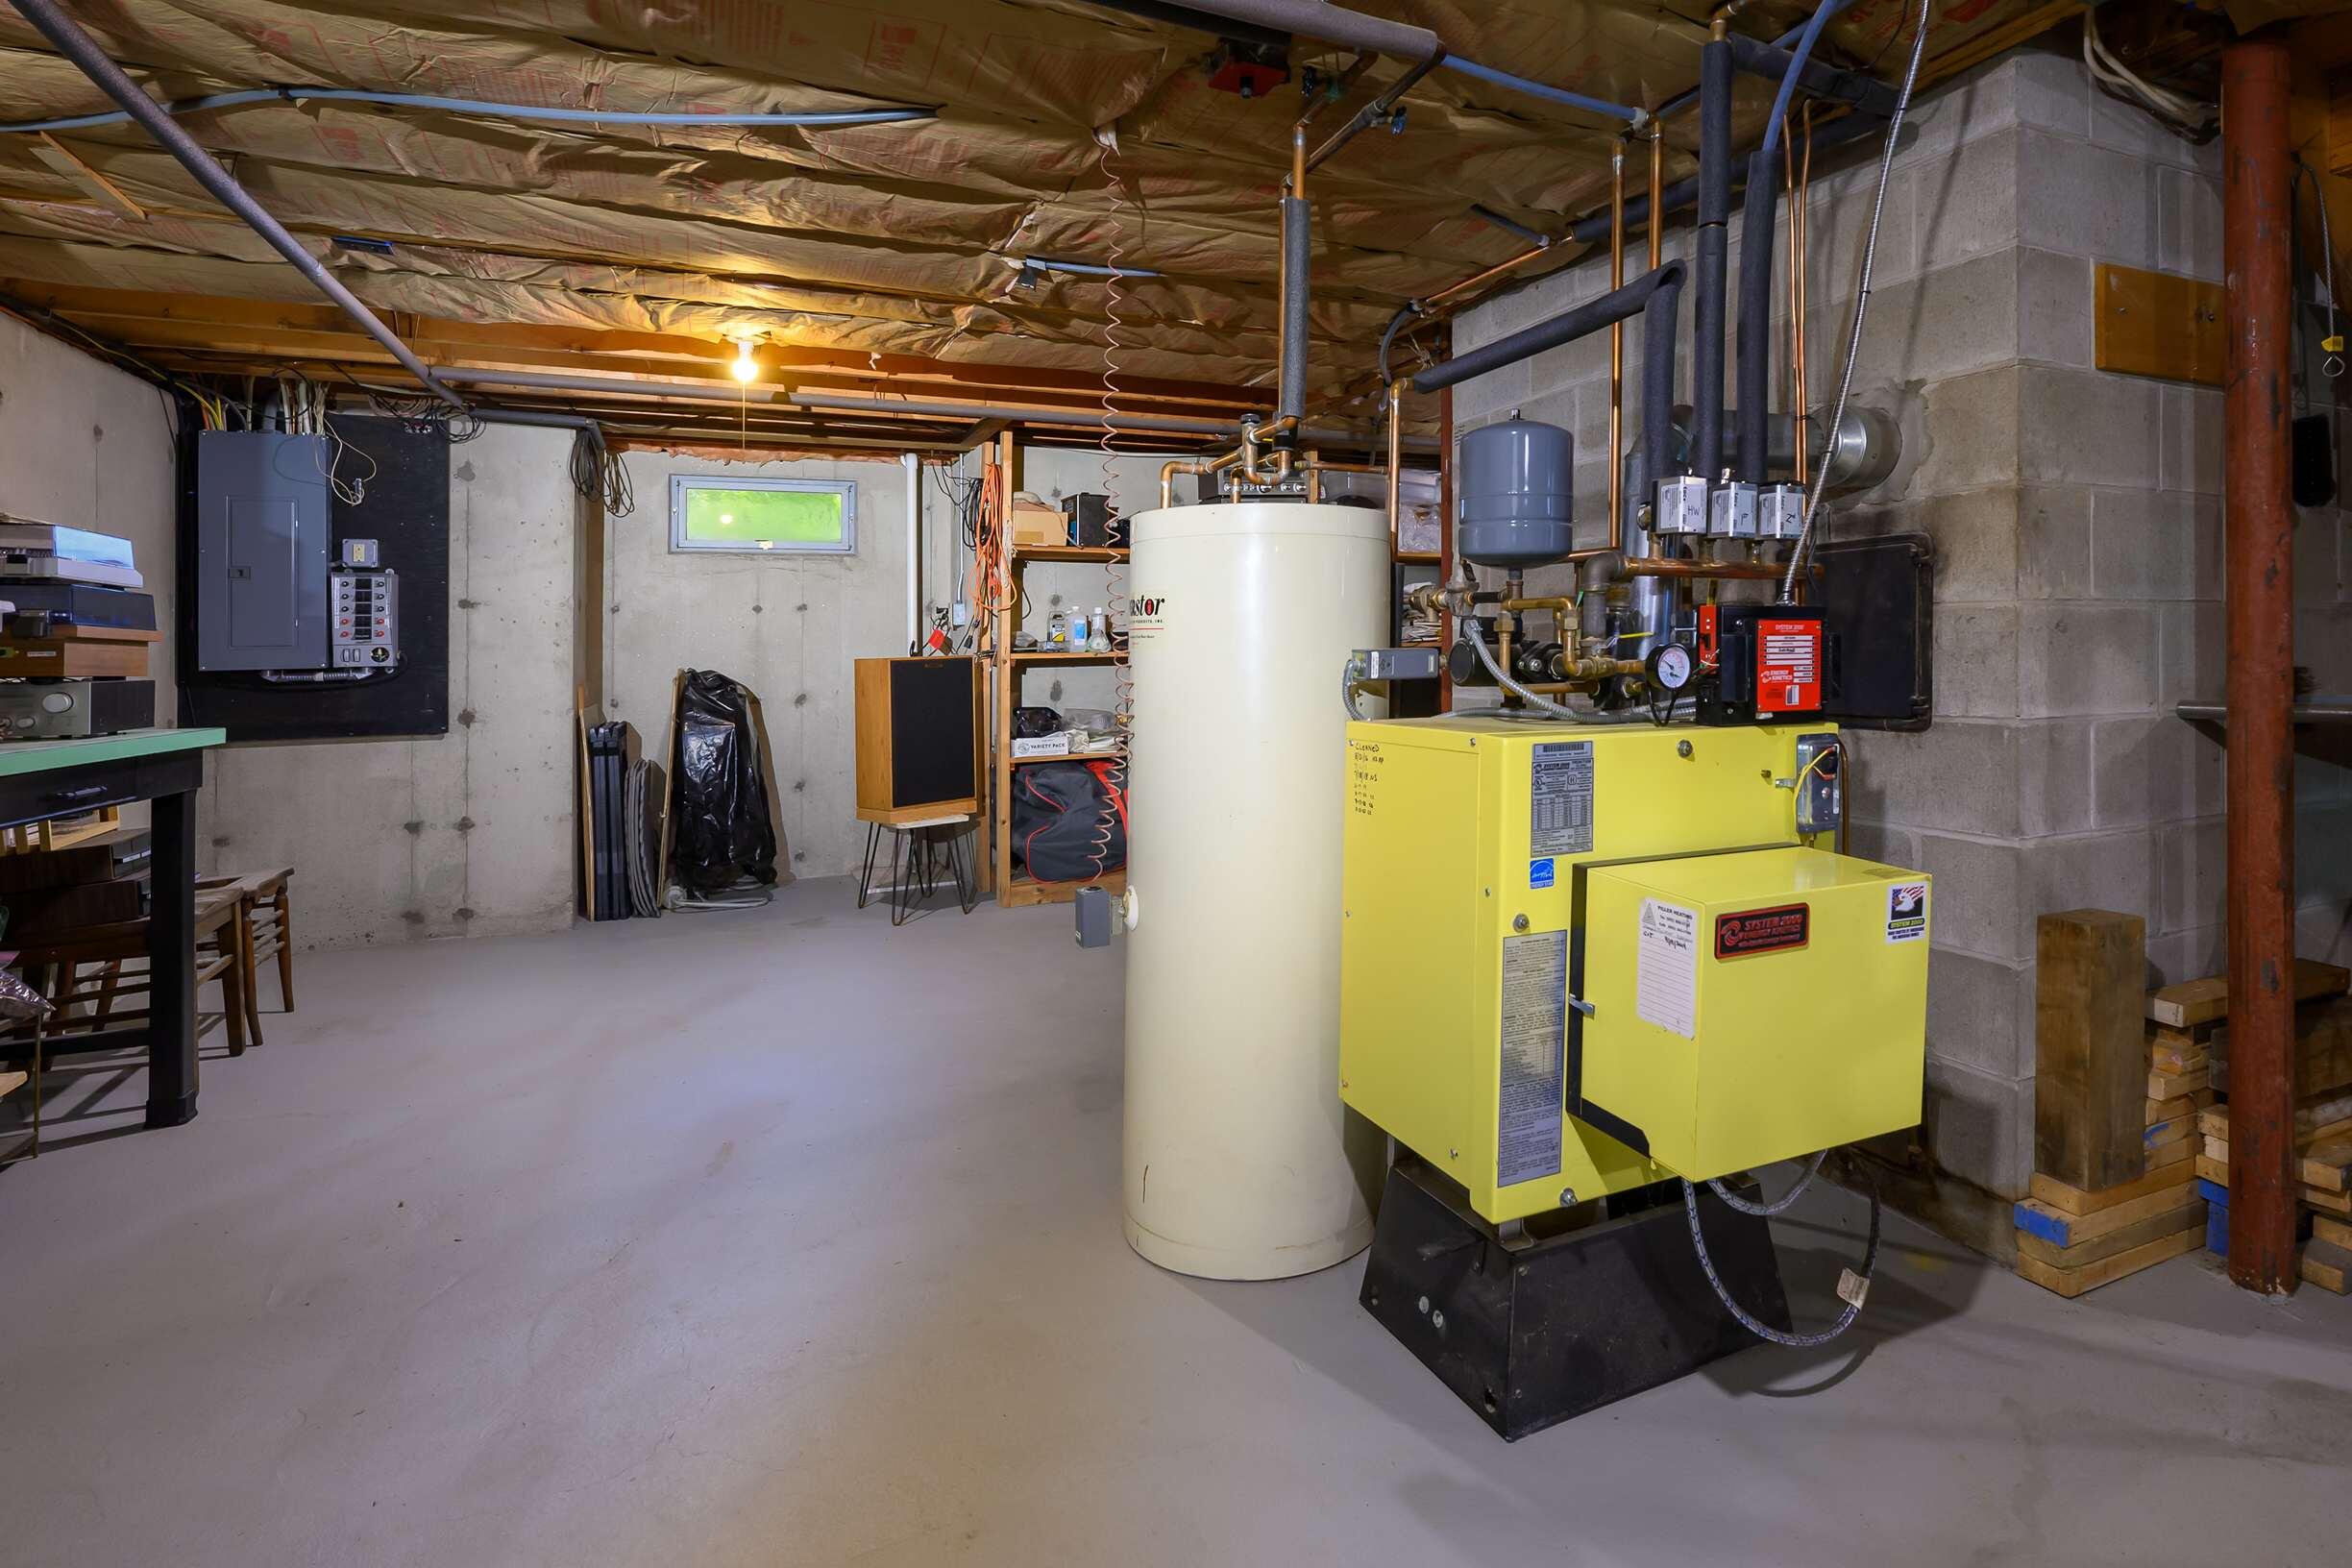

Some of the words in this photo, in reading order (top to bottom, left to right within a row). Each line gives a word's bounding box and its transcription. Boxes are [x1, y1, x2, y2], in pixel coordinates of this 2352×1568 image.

[1687, 505, 1700, 516] HW
[1745, 918, 1779, 931] SYSTEM
[1780, 914, 1803, 926] 2000
[1890, 920, 1910, 929] SYSTEM
